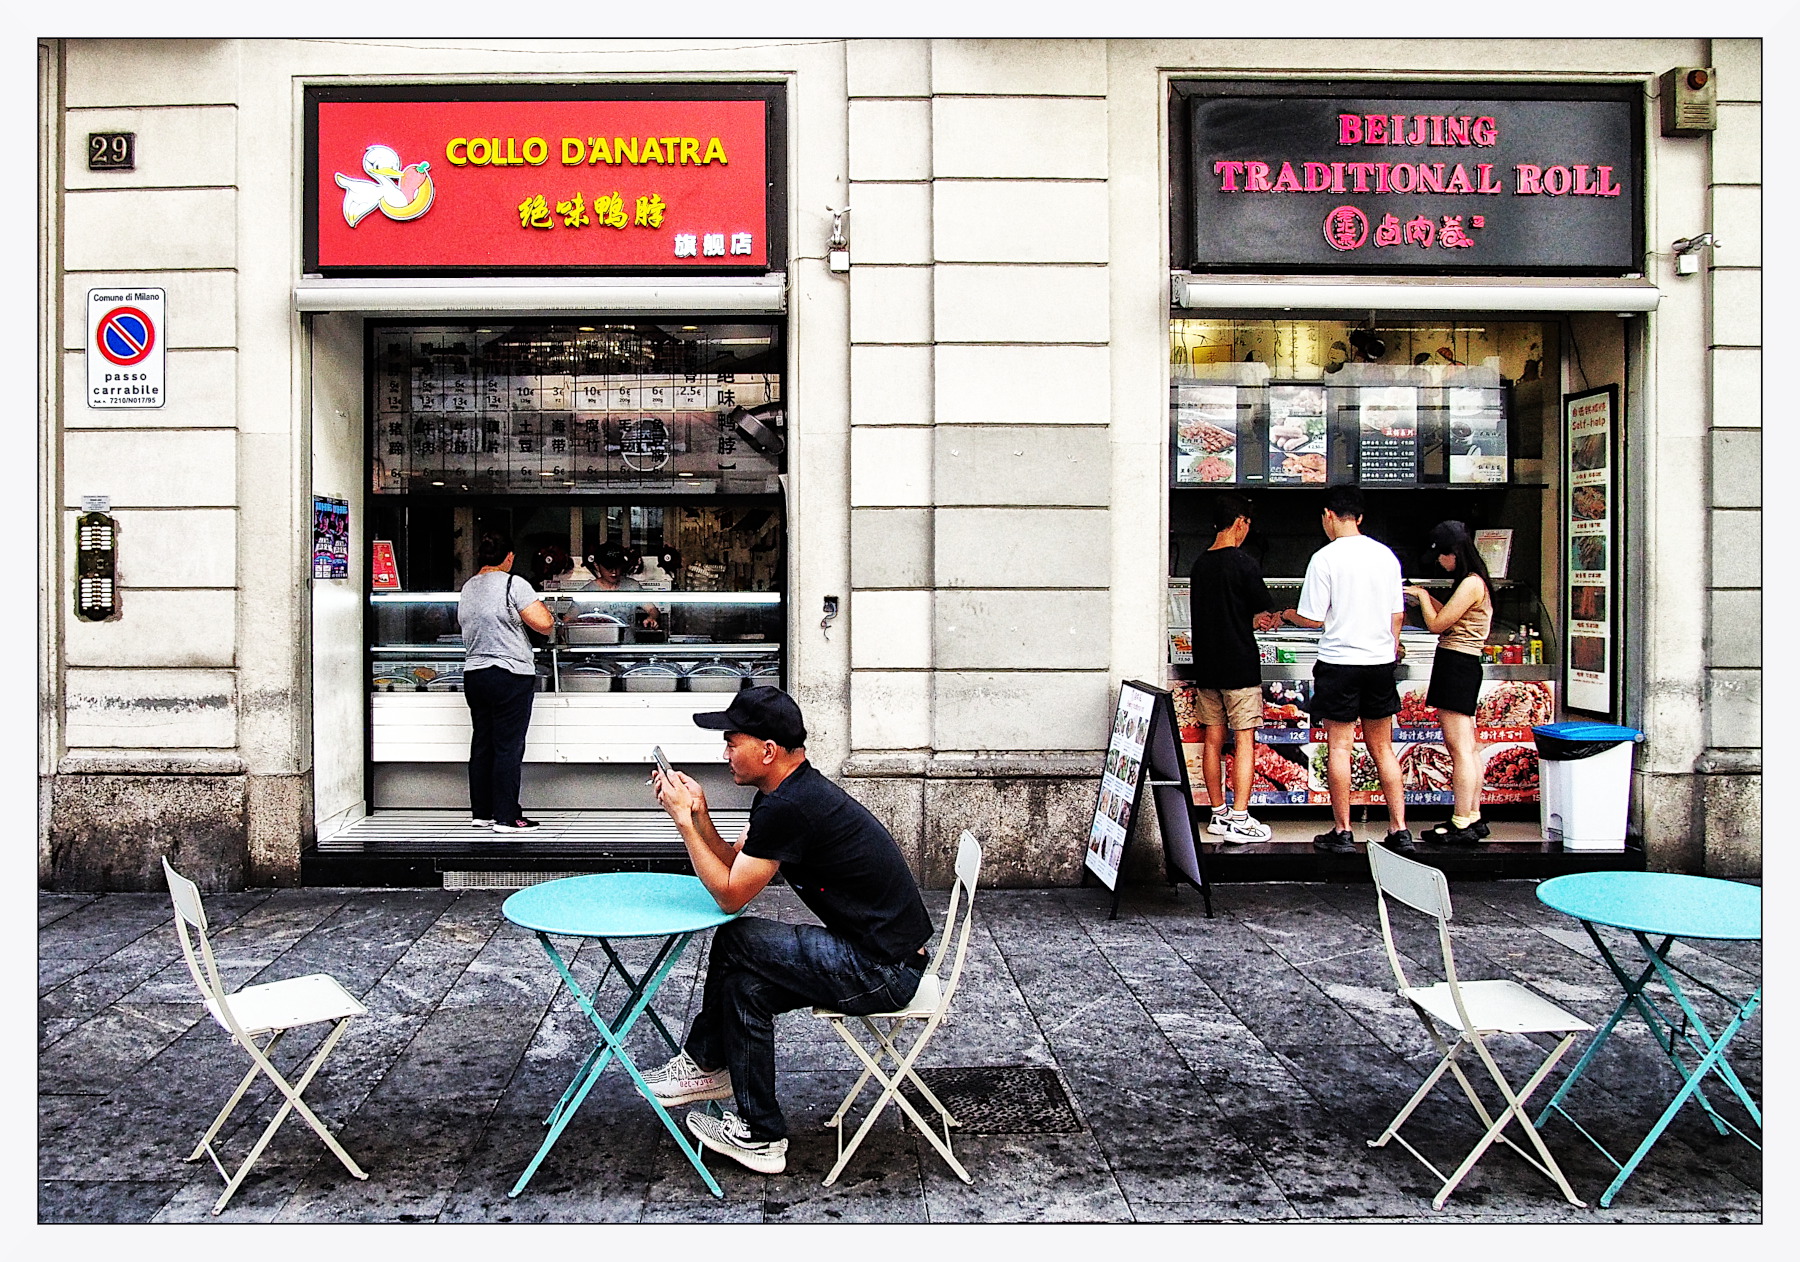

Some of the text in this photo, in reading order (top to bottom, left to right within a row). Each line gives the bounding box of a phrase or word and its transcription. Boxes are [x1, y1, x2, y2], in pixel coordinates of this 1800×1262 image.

[1336, 114, 1498, 146] BEIJING
[91, 136, 127, 162] 29
[445, 137, 728, 165] COLLO D'ANATRA
[1214, 161, 1621, 197] TRADITIONAL ROLL
[518, 191, 667, 230] 绝味鸭脖
[674, 233, 753, 257] 旗舰店
[93, 293, 160, 302] Comune di Milano
[105, 373, 147, 383] passo
[93, 385, 159, 395] carrabile
[619, 386, 631, 396] 6€
[652, 386, 664, 396] 6€
[680, 386, 702, 396] 2.5€
[1572, 417, 1606, 431] Self-help
[518, 420, 533, 453] 土豆
[1290, 732, 1306, 740] 12€
[1291, 795, 1305, 803] 6€
